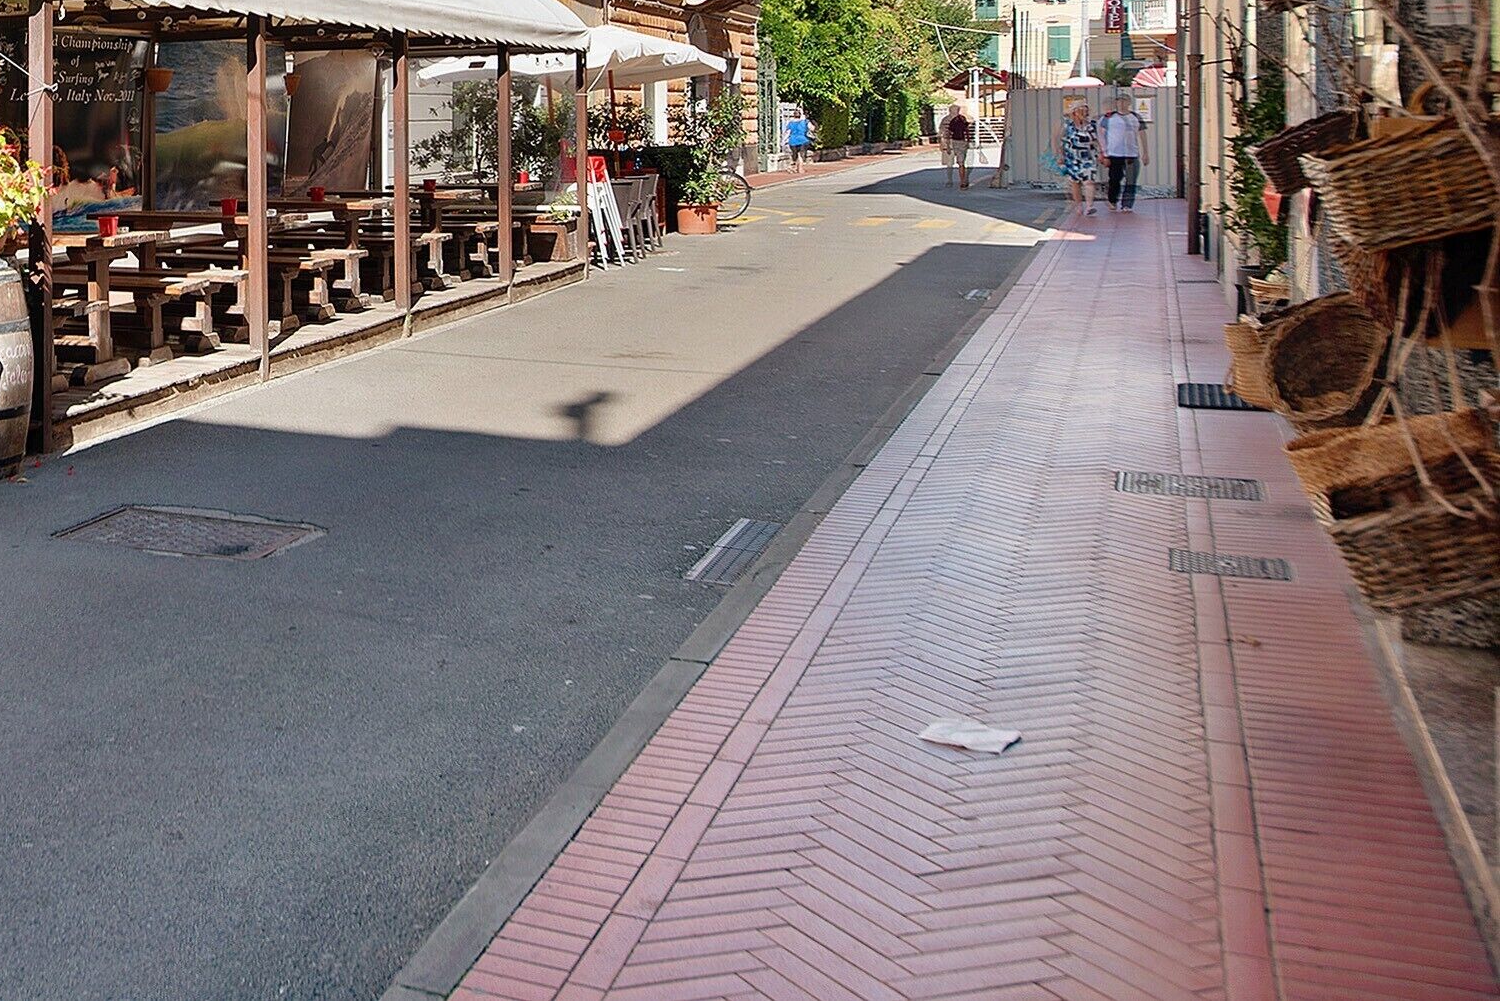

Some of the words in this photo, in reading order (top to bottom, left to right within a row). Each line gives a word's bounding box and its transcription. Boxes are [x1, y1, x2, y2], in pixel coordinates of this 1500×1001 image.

[61, 35, 134, 54] Championship
[70, 55, 81, 70] of
[57, 71, 94, 86] Surfing
[66, 88, 92, 104] Italy
